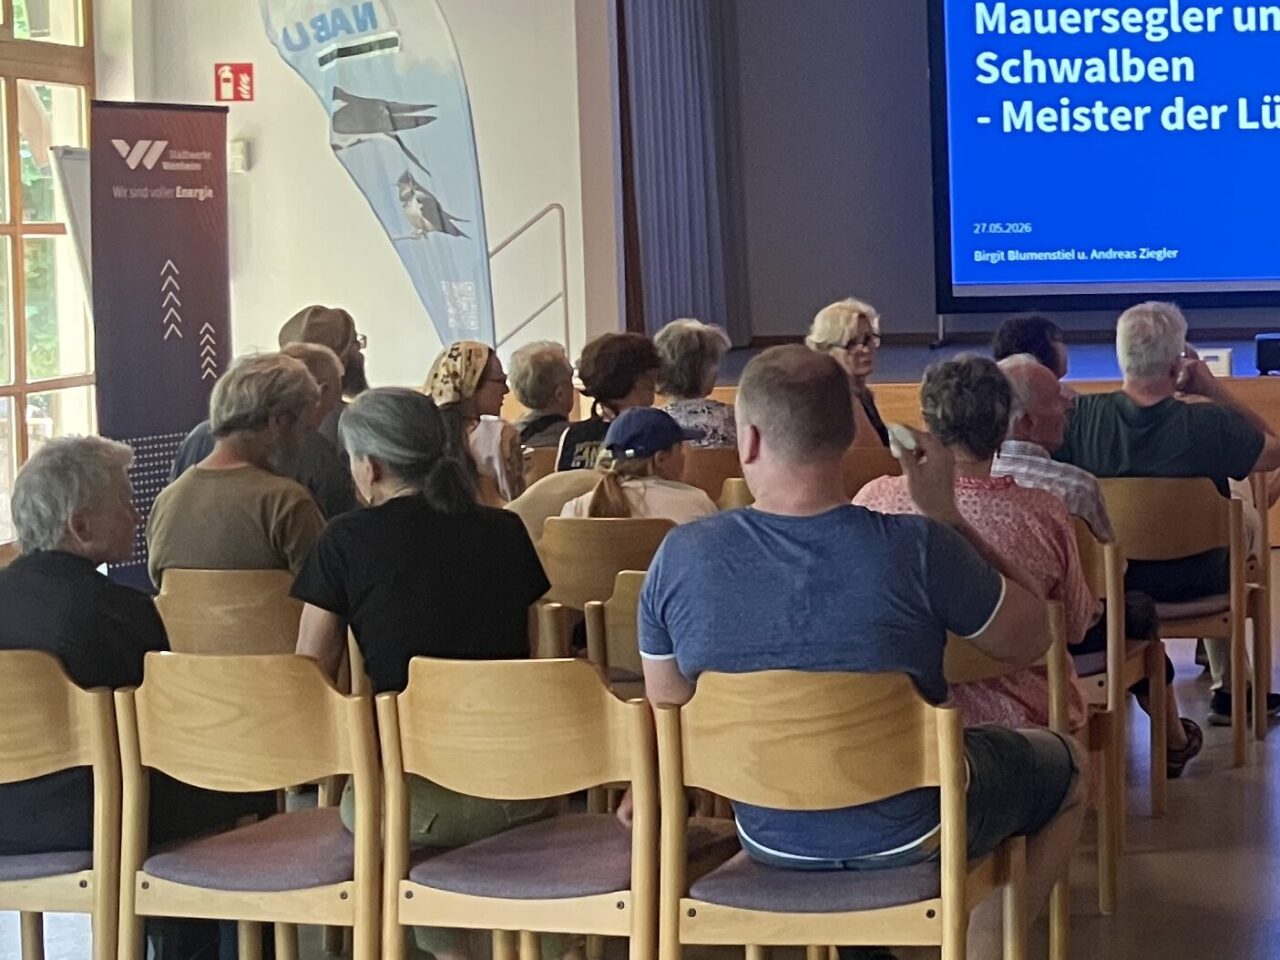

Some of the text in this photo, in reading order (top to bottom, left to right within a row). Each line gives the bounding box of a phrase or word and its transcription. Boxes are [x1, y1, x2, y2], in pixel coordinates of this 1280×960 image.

[975, 48, 1195, 84] Schwalben
[1002, 97, 1151, 133] Meister
[1160, 96, 1228, 131] der
[175, 185, 213, 201] Energie
[973, 222, 1033, 234] 27.05.2026
[974, 247, 1179, 264] Birgit Blumenstiel u. Andreas Ziegler
